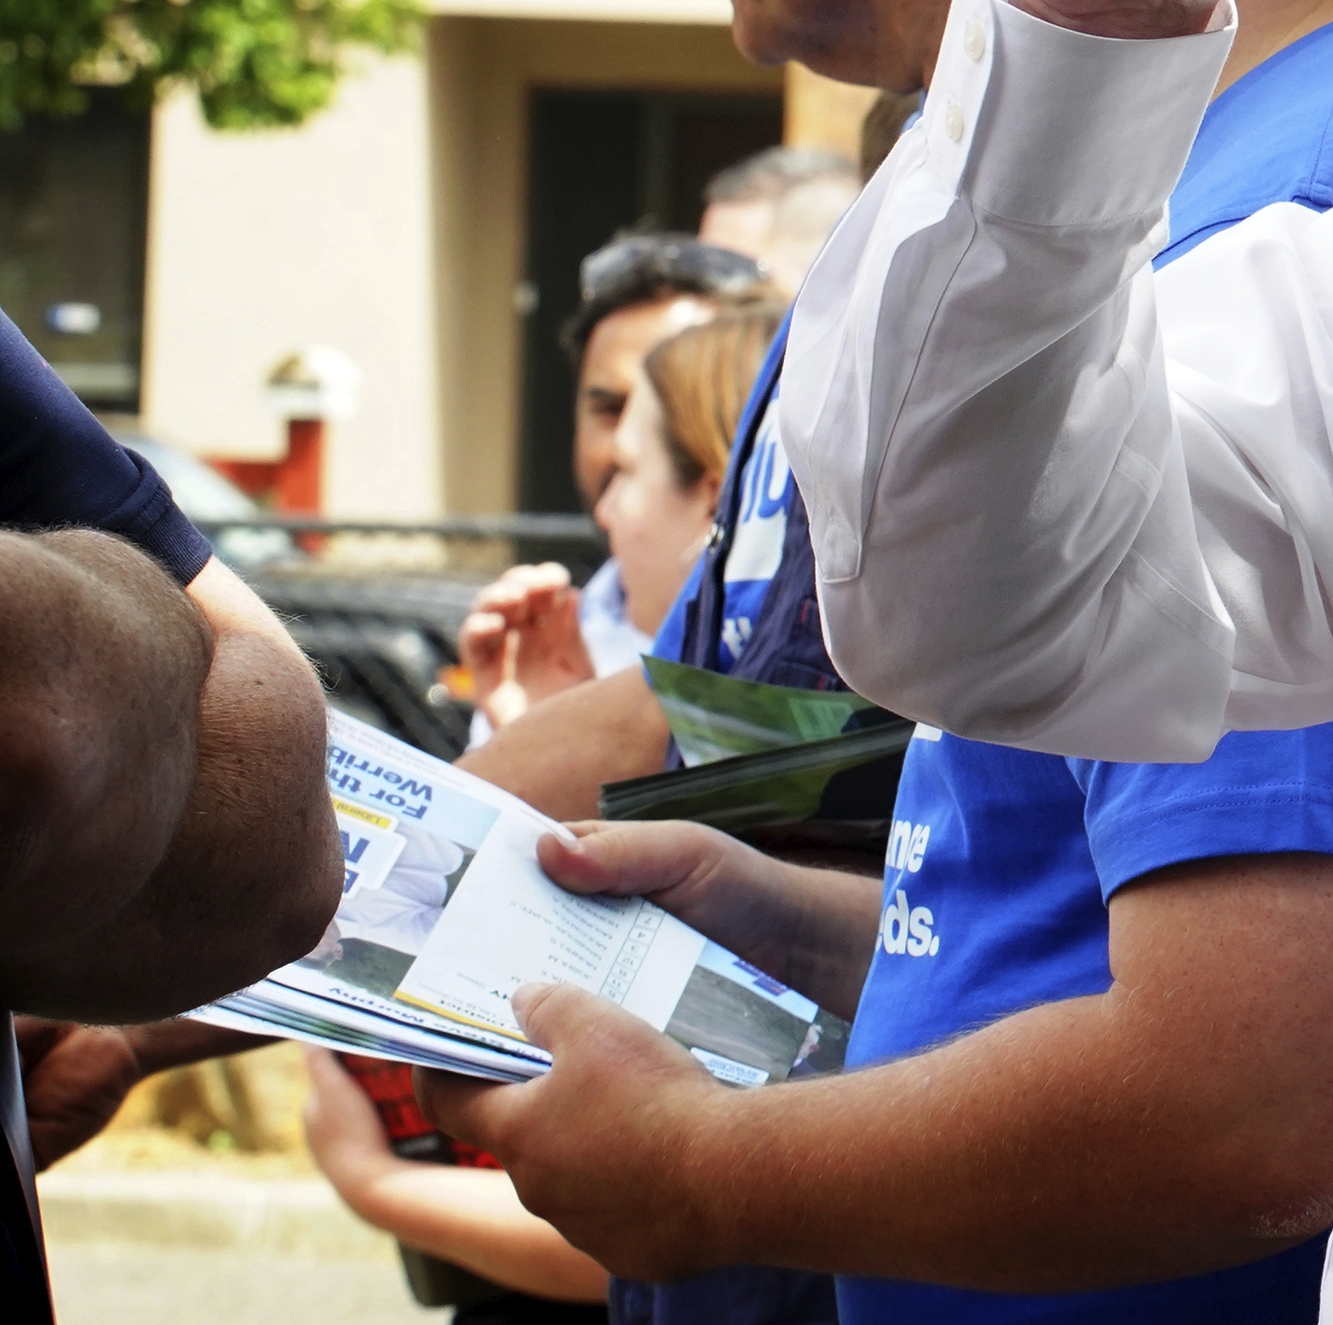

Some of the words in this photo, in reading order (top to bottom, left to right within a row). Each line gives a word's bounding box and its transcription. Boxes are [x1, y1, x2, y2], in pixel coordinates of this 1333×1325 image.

[326, 745, 434, 802] Werrib
[326, 768, 361, 795] th
[368, 789, 429, 820] For
